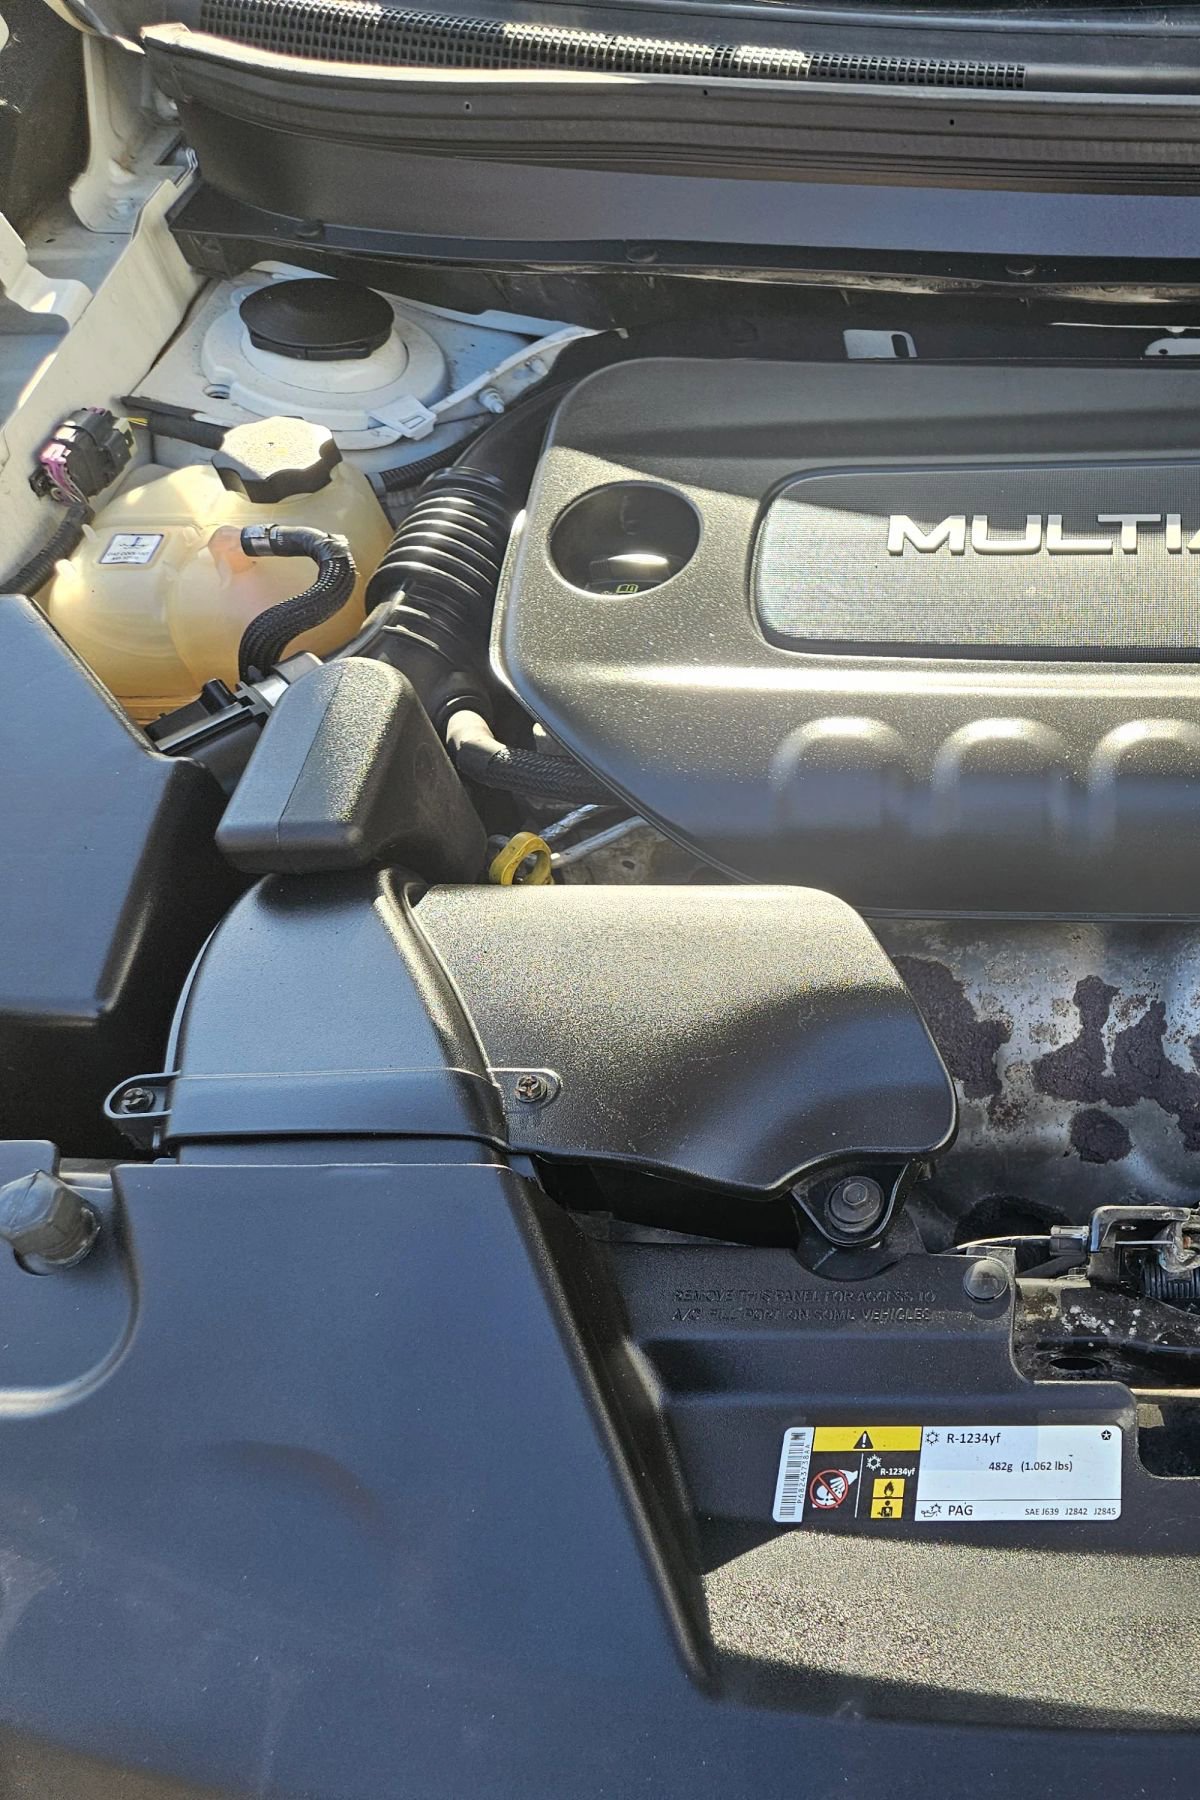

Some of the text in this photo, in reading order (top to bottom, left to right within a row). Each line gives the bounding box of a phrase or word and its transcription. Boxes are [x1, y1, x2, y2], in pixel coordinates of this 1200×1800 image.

[946, 1432, 1001, 1445] R-1234yf
[880, 1467, 916, 1476] R-1234yf
[988, 1460, 1073, 1473] 482g (1.062 lbs)
[948, 1504, 974, 1517] PAG
[1024, 1507, 1117, 1517] SAE J639 J2842 J2845
